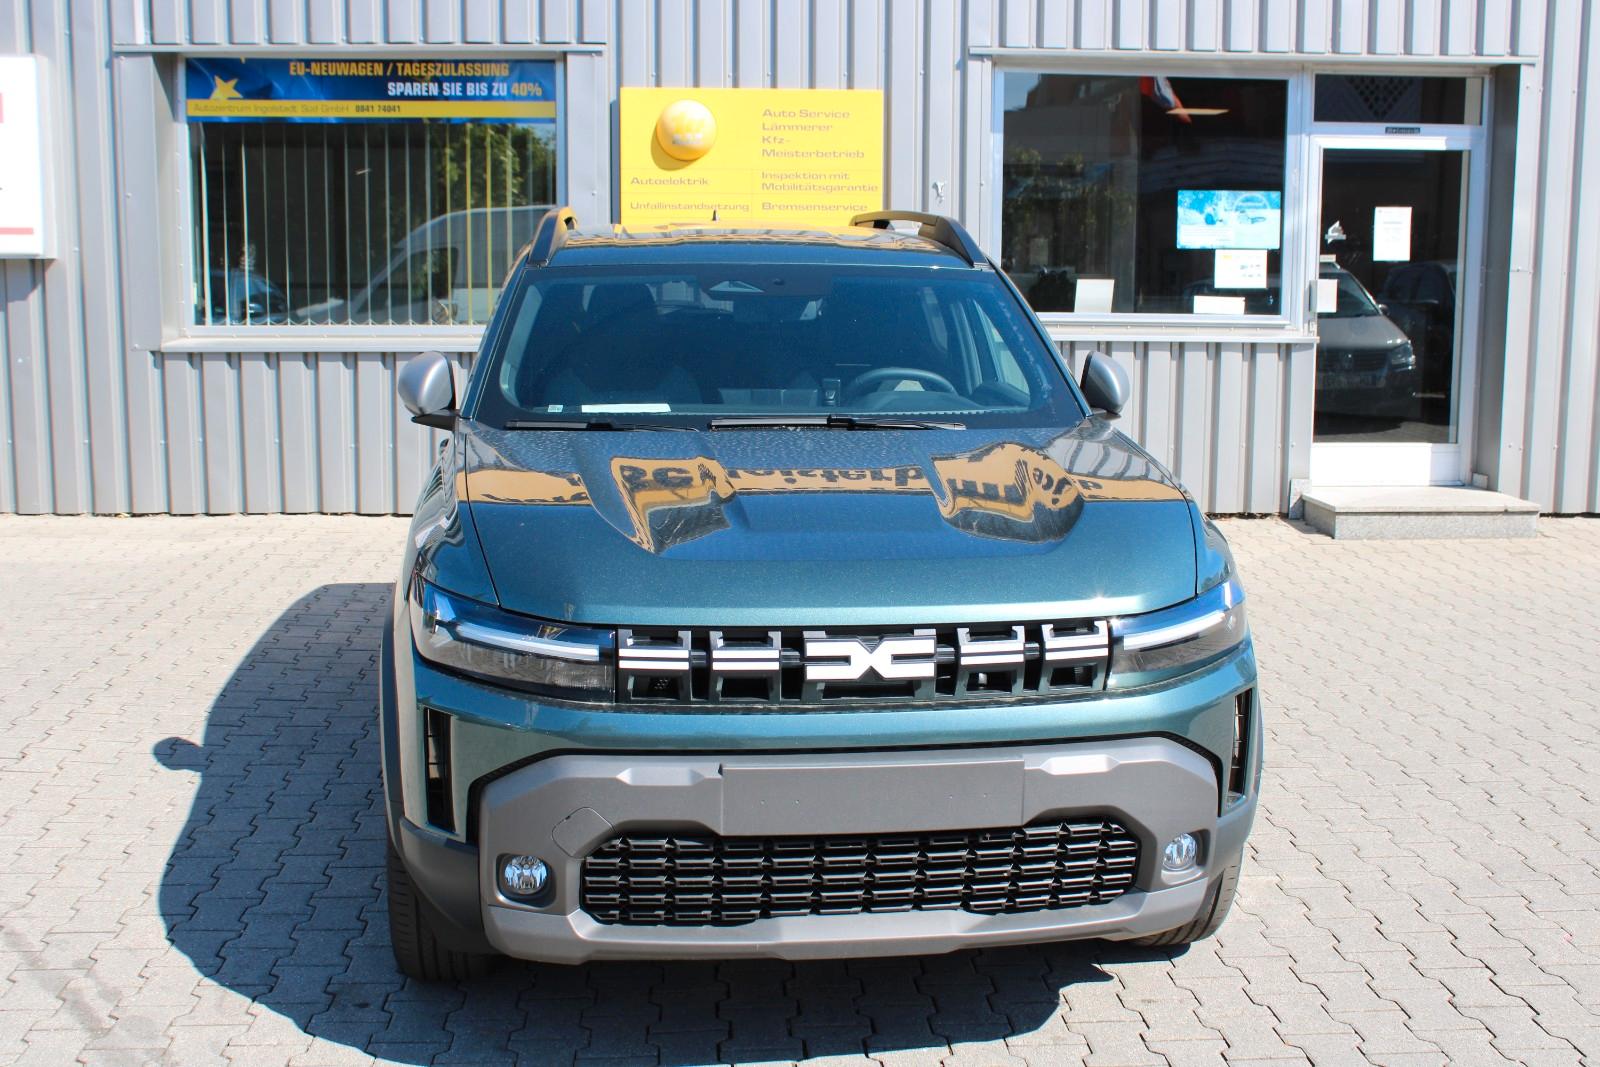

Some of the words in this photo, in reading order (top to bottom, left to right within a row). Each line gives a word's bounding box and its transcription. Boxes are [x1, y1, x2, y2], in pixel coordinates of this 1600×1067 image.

[289, 61, 384, 77] EU-NEUWAGEN
[396, 62, 510, 78] TAGESZULASSUNG
[387, 82, 439, 97] SPAREN
[442, 82, 463, 97] SIE
[467, 82, 489, 97] BIS
[492, 82, 508, 97] ZU
[511, 82, 543, 97] 40%
[193, 102, 251, 114] Autozentrum
[762, 109, 796, 118] Auto
[799, 109, 850, 119] Service
[762, 135, 790, 144] Kfz-
[761, 149, 865, 159] Meisterbetrieb
[630, 176, 709, 185] Autoelektrik
[761, 172, 826, 182] Inspektion
[827, 172, 849, 181] mit
[761, 182, 879, 194] Mobilitätsgarantie
[630, 201, 750, 213] Unfallinstandsetzung
[761, 202, 868, 212] Bremsenservice
